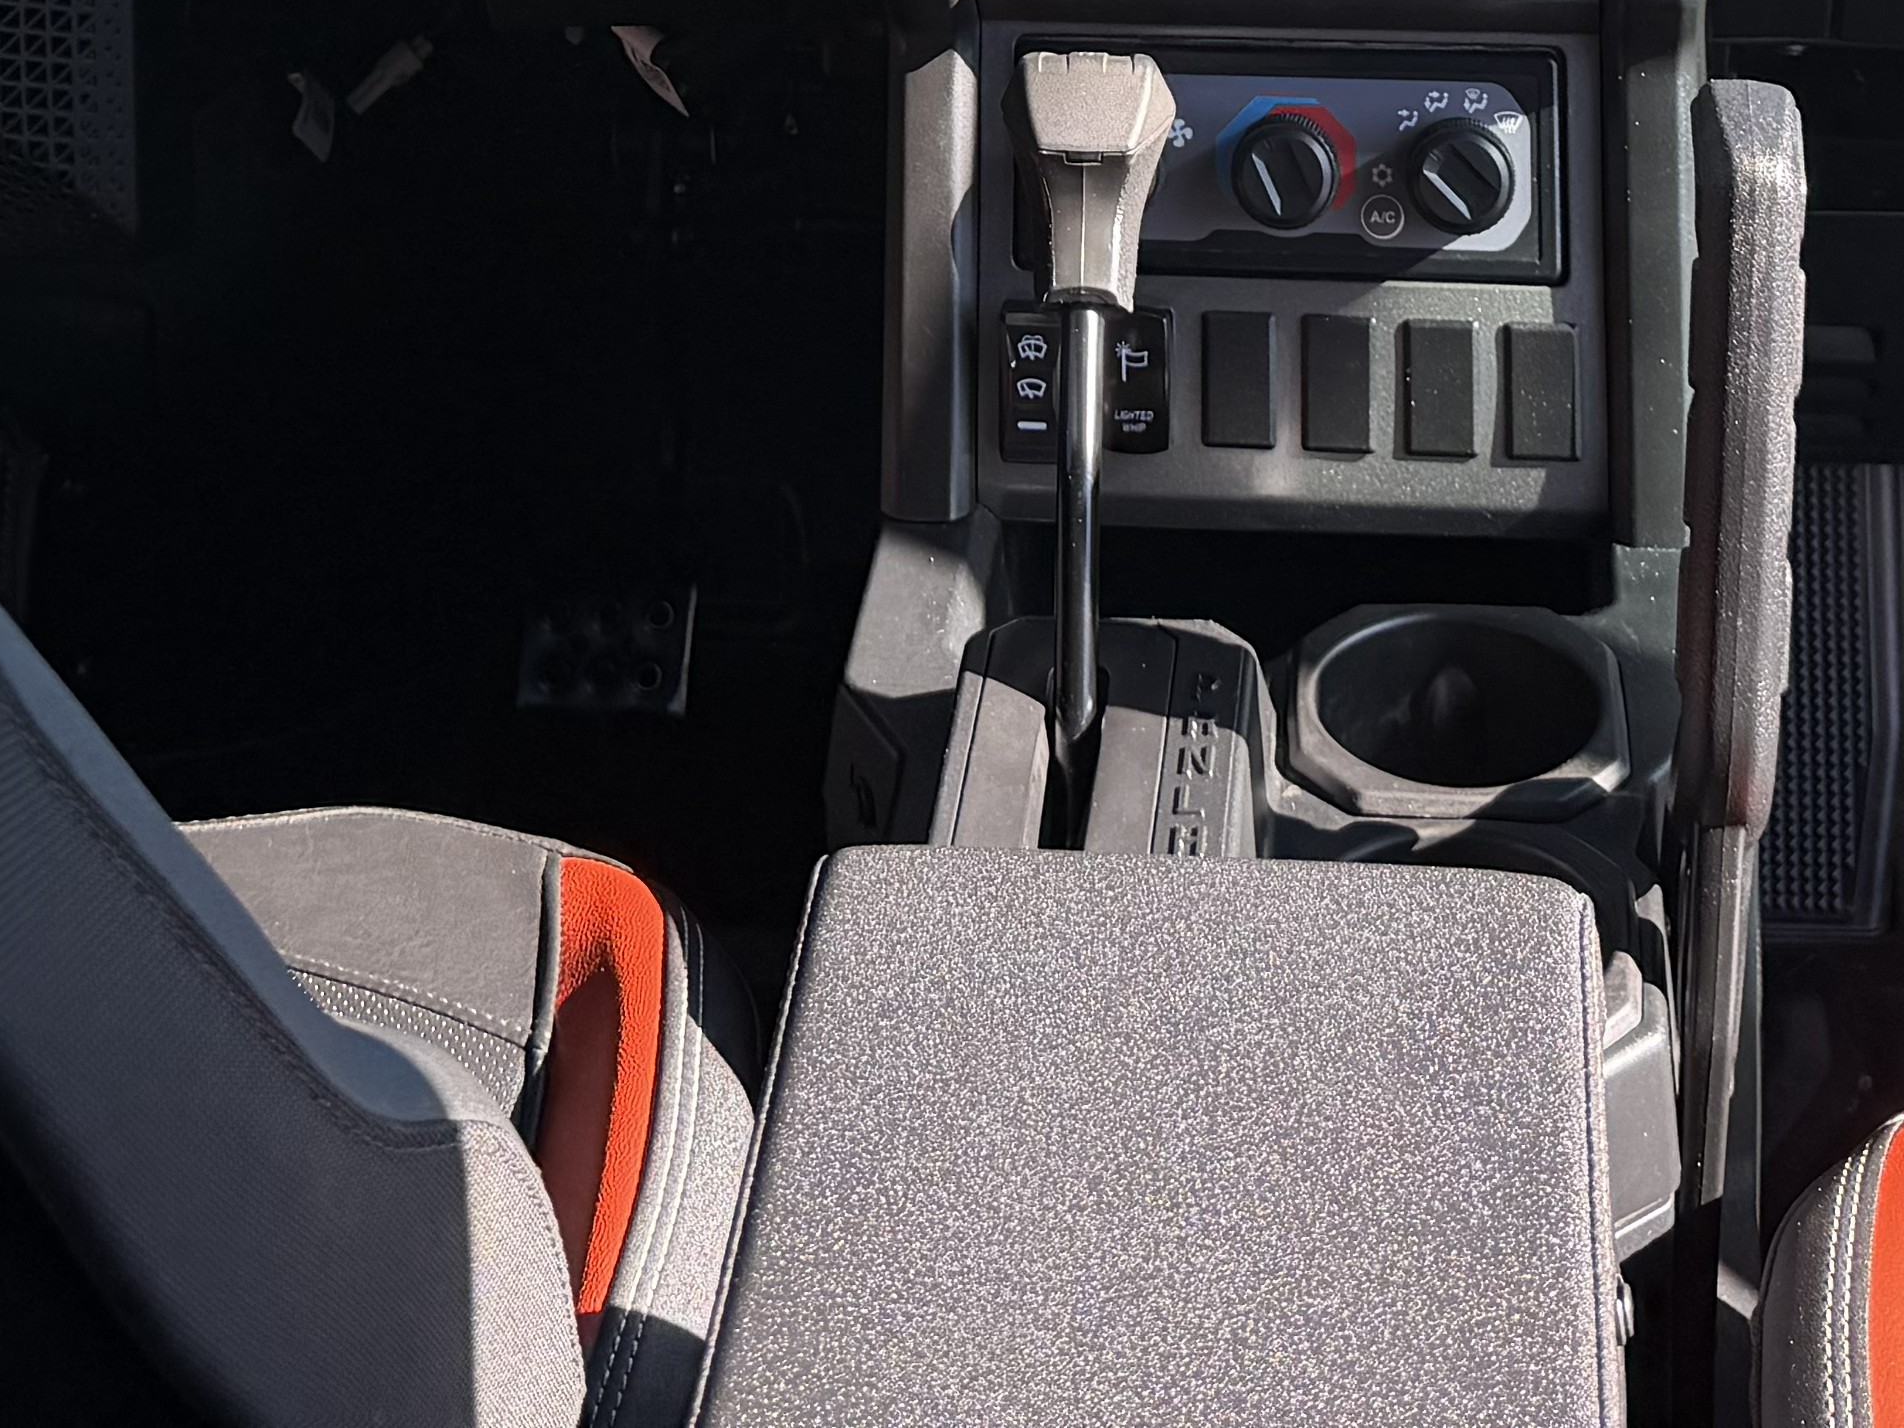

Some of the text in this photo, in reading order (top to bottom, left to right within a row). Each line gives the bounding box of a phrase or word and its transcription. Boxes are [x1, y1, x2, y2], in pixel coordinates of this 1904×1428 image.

[1370, 210, 1395, 223] A/C
[1176, 745, 1217, 780] N
[1172, 784, 1206, 819] L
